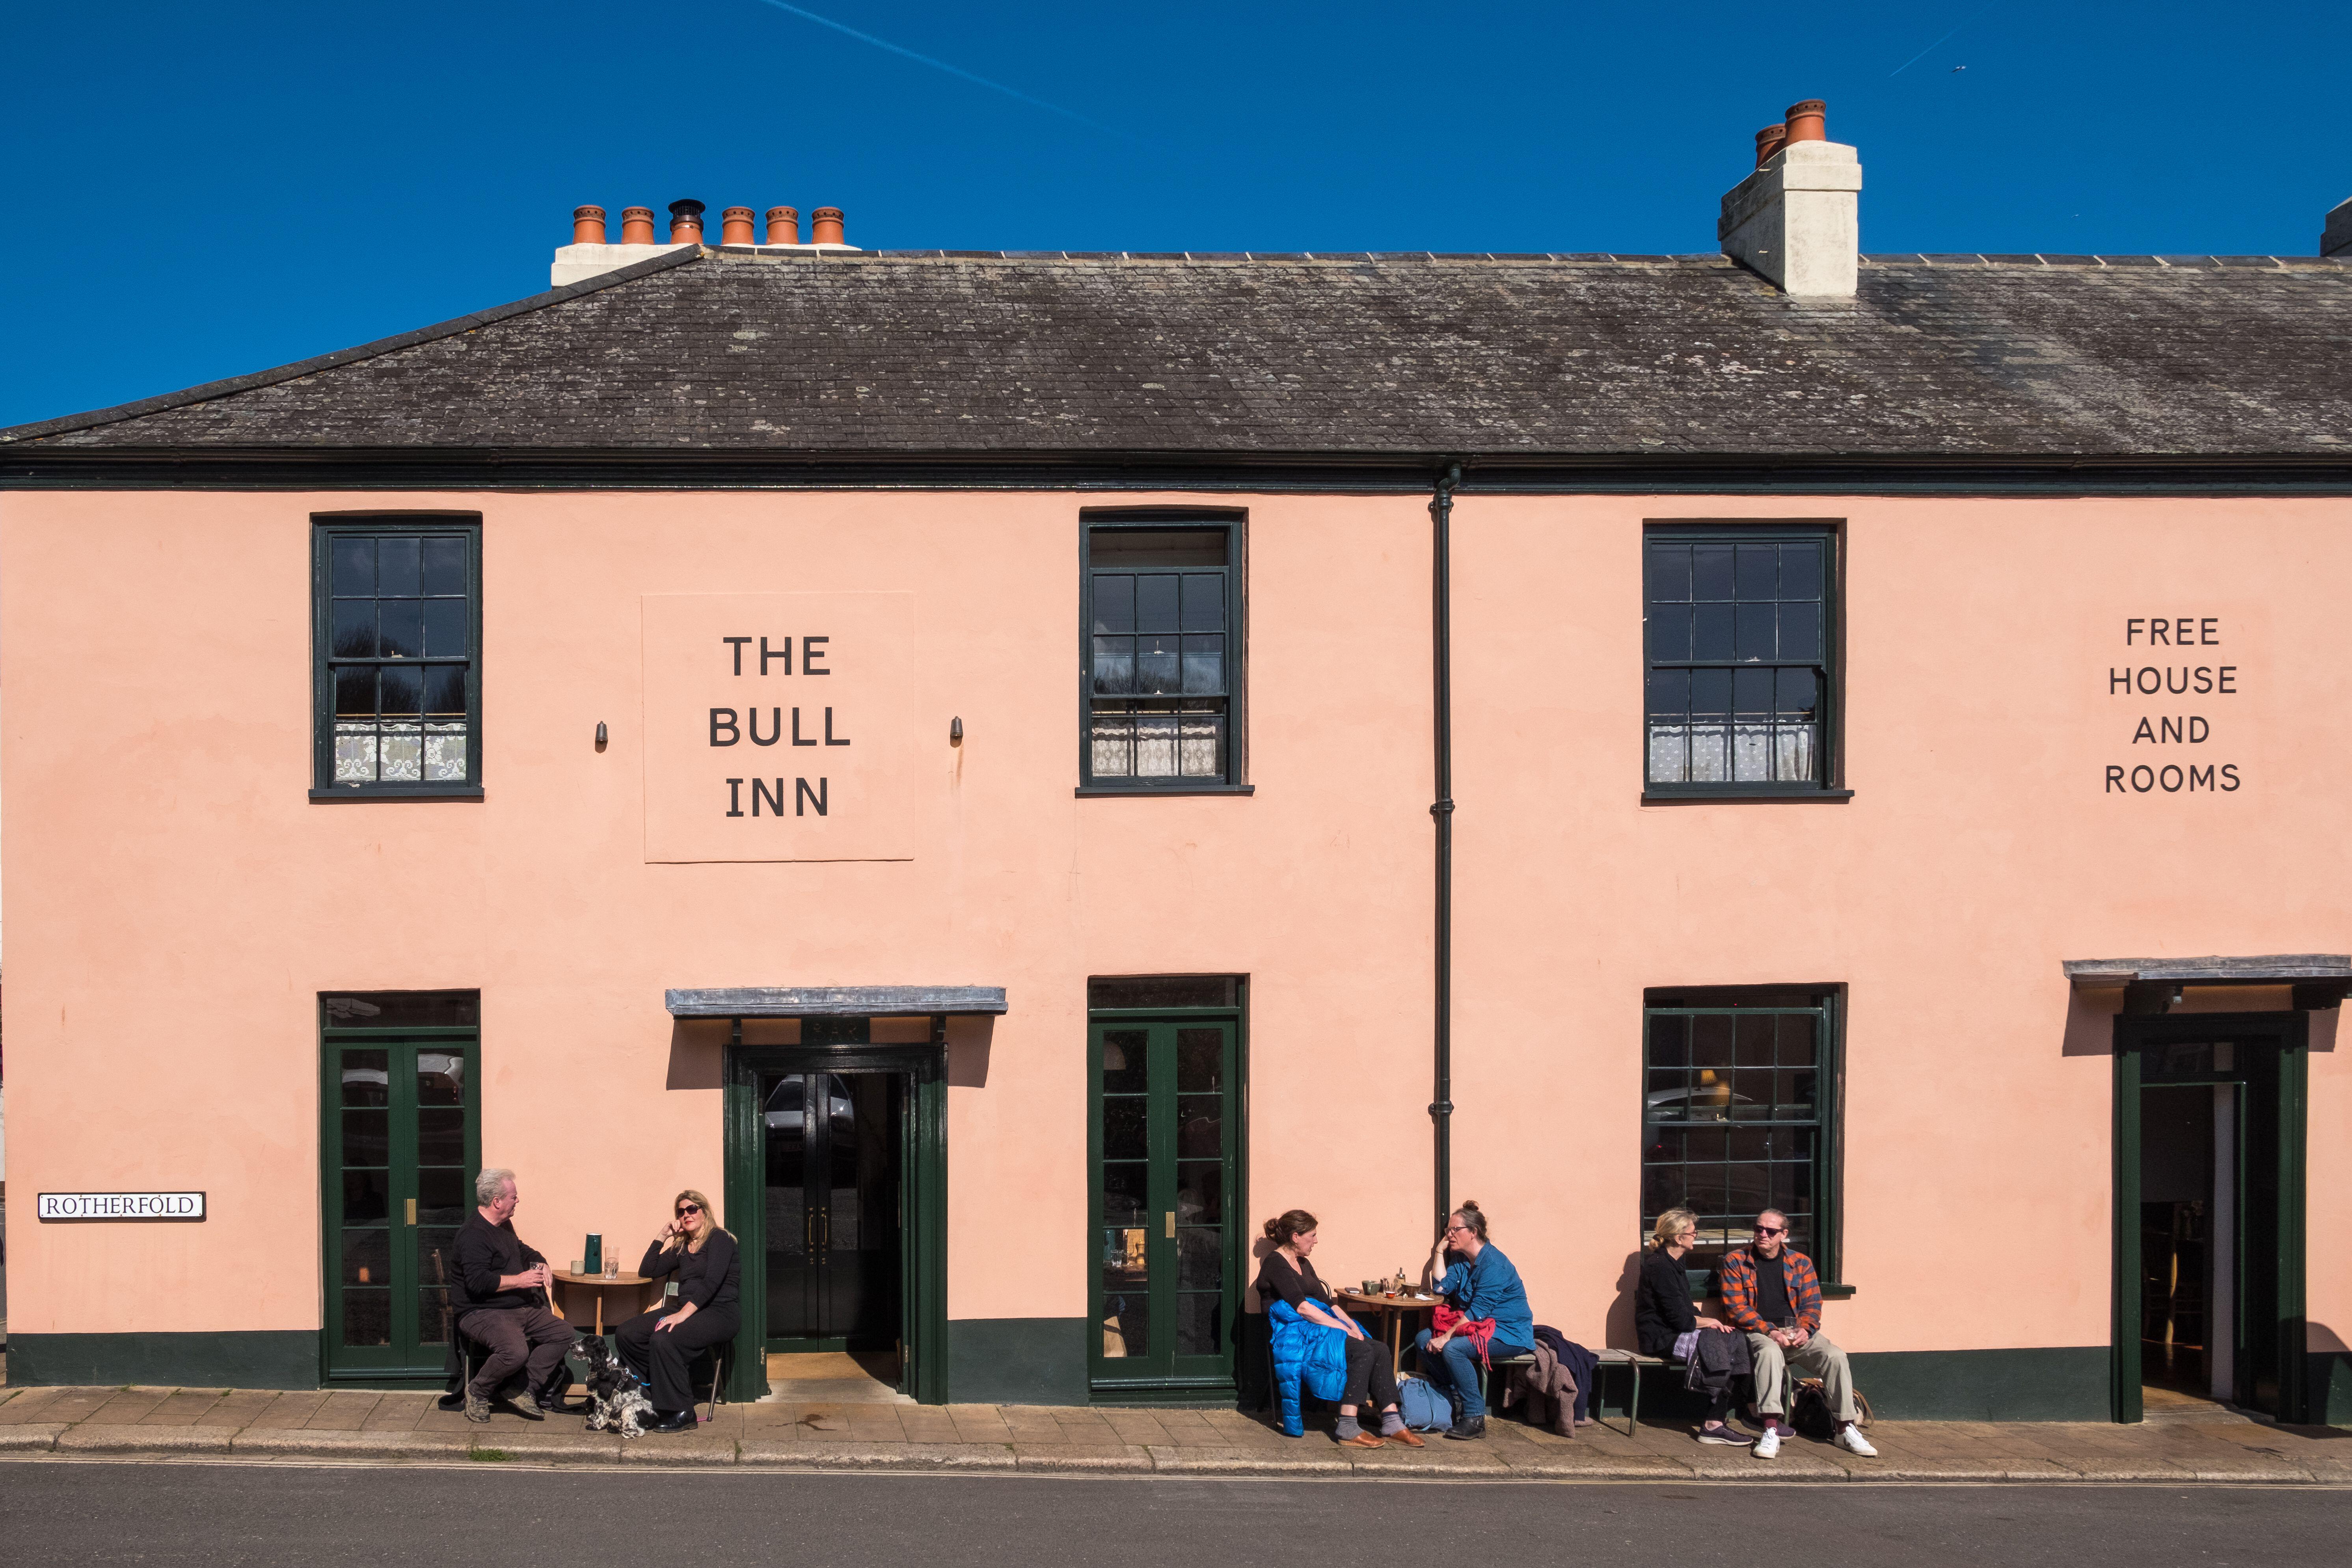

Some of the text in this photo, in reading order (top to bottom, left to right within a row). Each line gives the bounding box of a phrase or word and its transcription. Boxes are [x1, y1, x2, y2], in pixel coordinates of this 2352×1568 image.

[2127, 618, 2219, 645] FREE
[723, 637, 830, 676] THE
[2110, 667, 2236, 694] HOUSE
[710, 707, 850, 747] BULL
[2132, 717, 2209, 743] AND
[2106, 764, 2240, 793] ROOMS
[726, 778, 827, 817] INN
[47, 1197, 193, 1214] ROTHERFOLD
